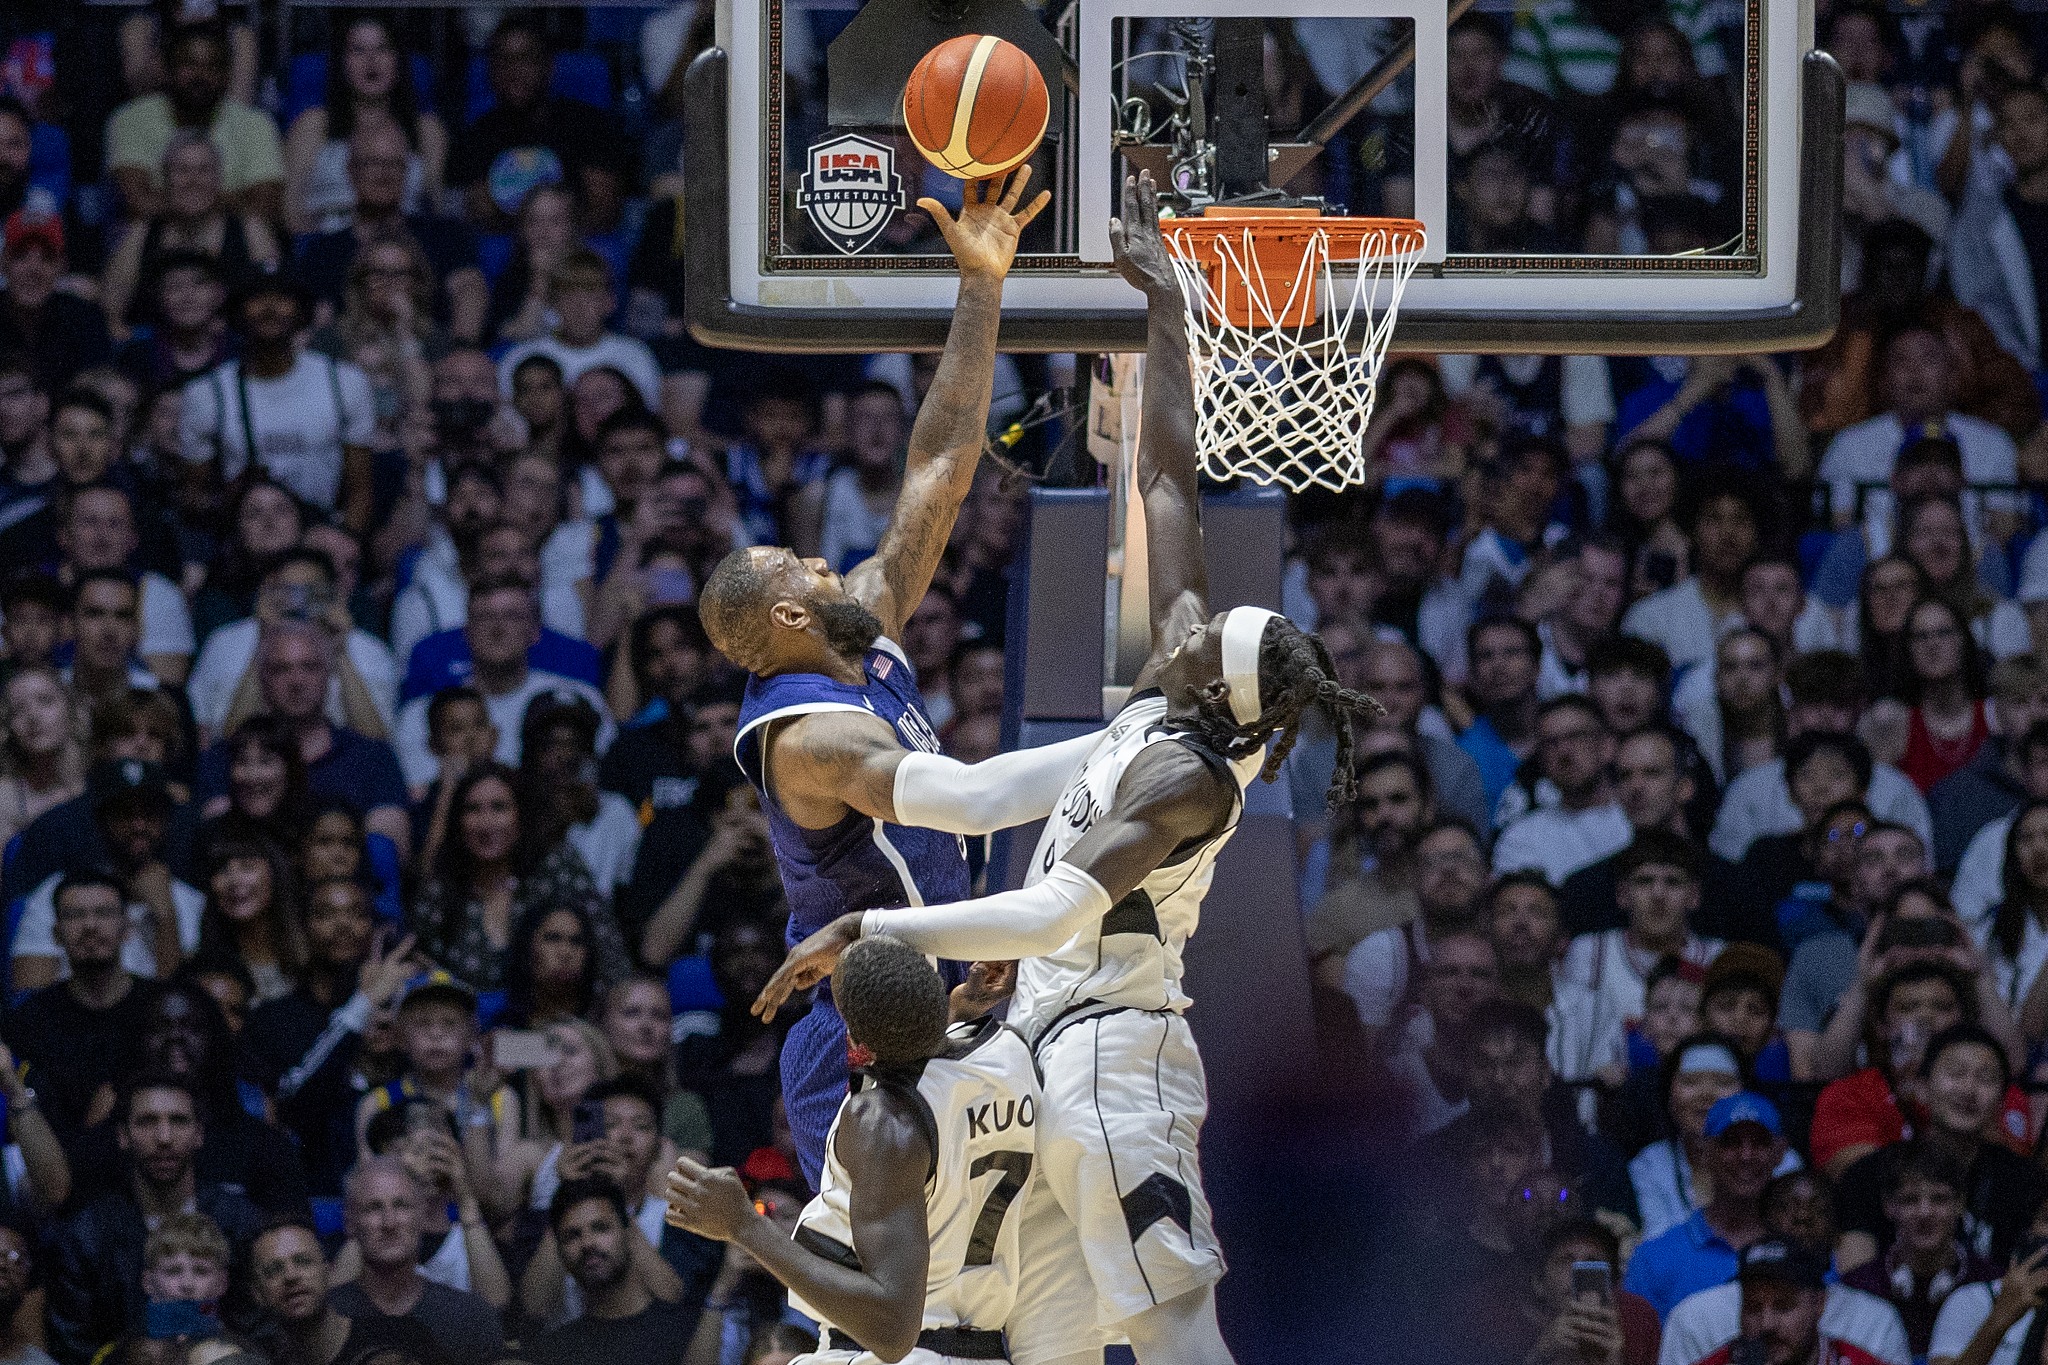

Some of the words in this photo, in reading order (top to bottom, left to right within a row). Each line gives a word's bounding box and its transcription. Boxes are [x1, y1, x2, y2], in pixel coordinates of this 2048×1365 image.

[820, 154, 883, 184] USA
[804, 191, 897, 202] BASKETBALL
[966, 1094, 1035, 1139] KUO
[963, 1149, 1034, 1266] 7
